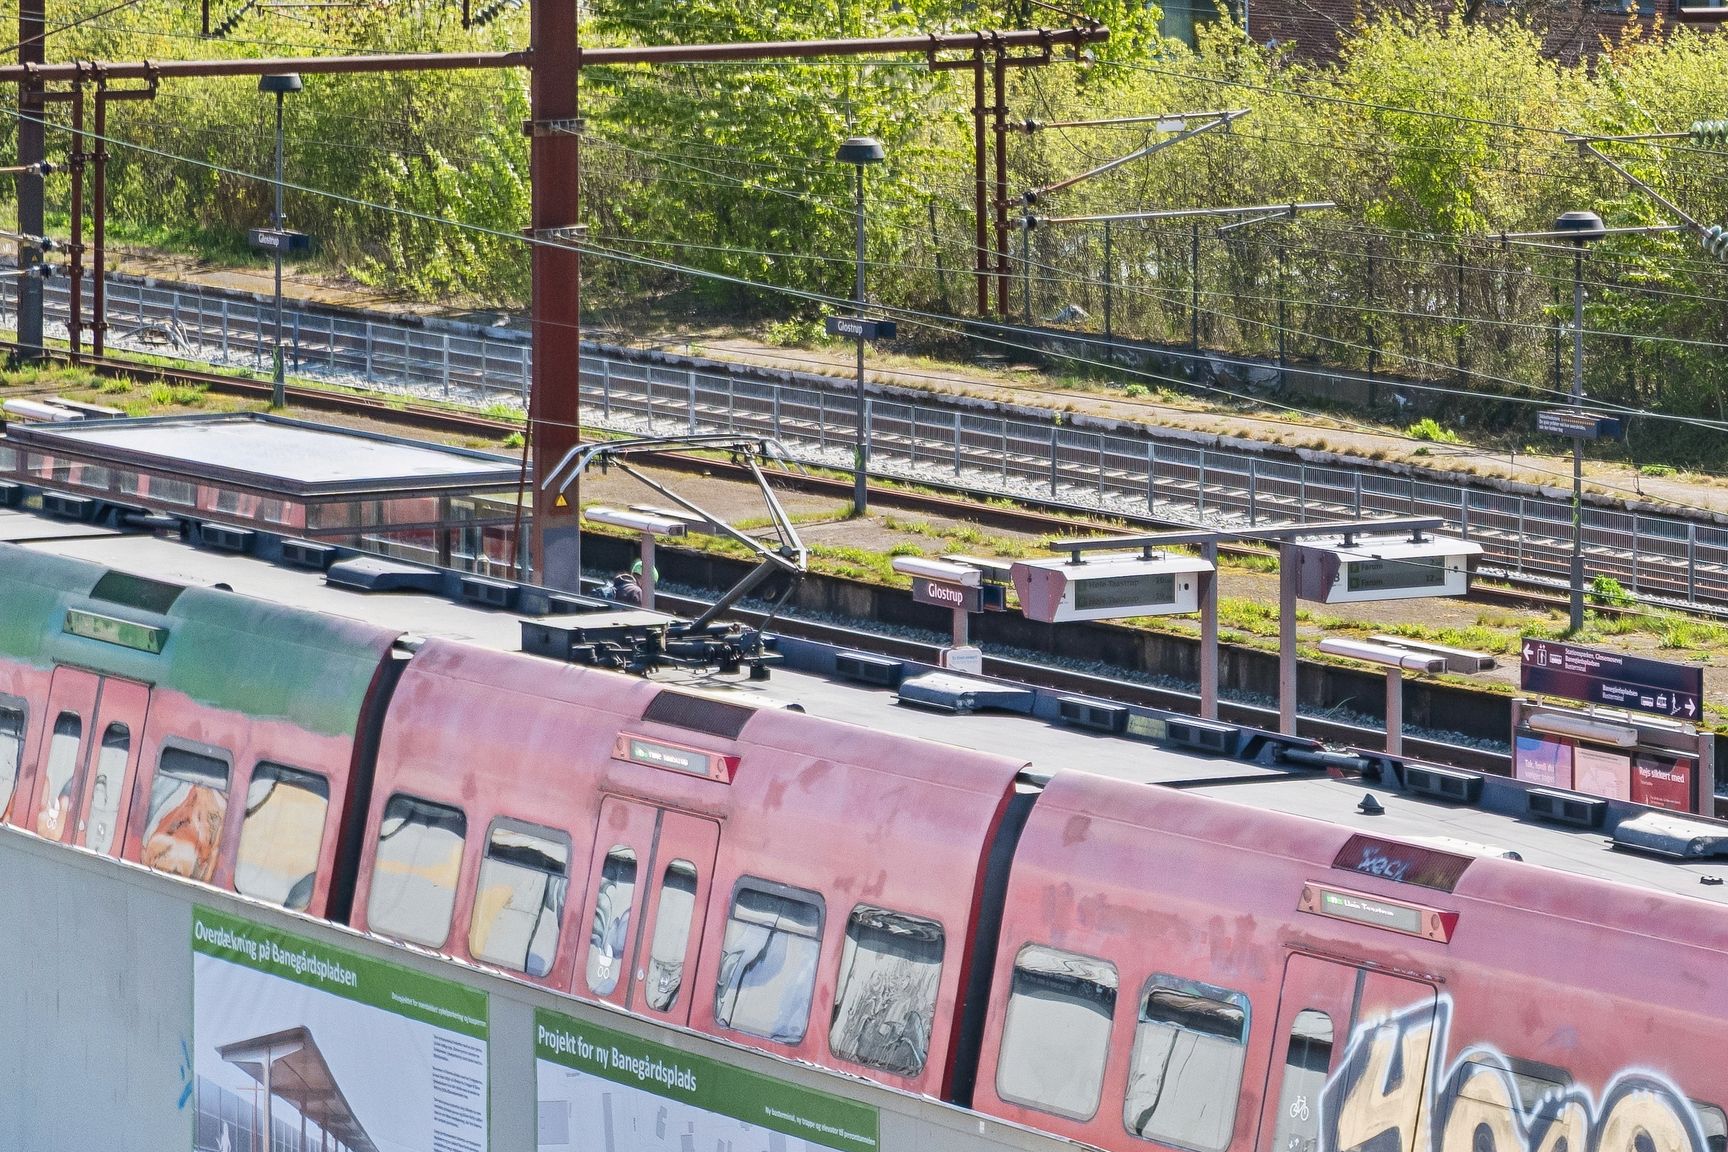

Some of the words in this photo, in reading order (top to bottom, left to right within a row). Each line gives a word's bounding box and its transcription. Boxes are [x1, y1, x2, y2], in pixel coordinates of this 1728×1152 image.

[838, 320, 863, 335] Glostrup
[1361, 562, 1384, 571] Farum
[1361, 578, 1384, 586] Farum
[928, 583, 963, 606] Glostrup
[1639, 766, 1651, 778] Rejs
[1651, 769, 1671, 781] sikkert
[1671, 773, 1685, 784] med
[195, 921, 256, 960] Overdækning
[258, 944, 270, 962] på
[272, 946, 358, 988] Banegårdspladsen
[539, 1024, 577, 1056] Projekt
[577, 1034, 594, 1060] for
[596, 1046, 609, 1070] ny
[611, 1046, 697, 1092] Banegårdsplads
[765, 1106, 772, 1116] Ny
[796, 1117, 802, 1126] ny
[802, 1117, 815, 1129] trappe
[815, 1123, 821, 1132] og
[821, 1123, 839, 1135] elevator
